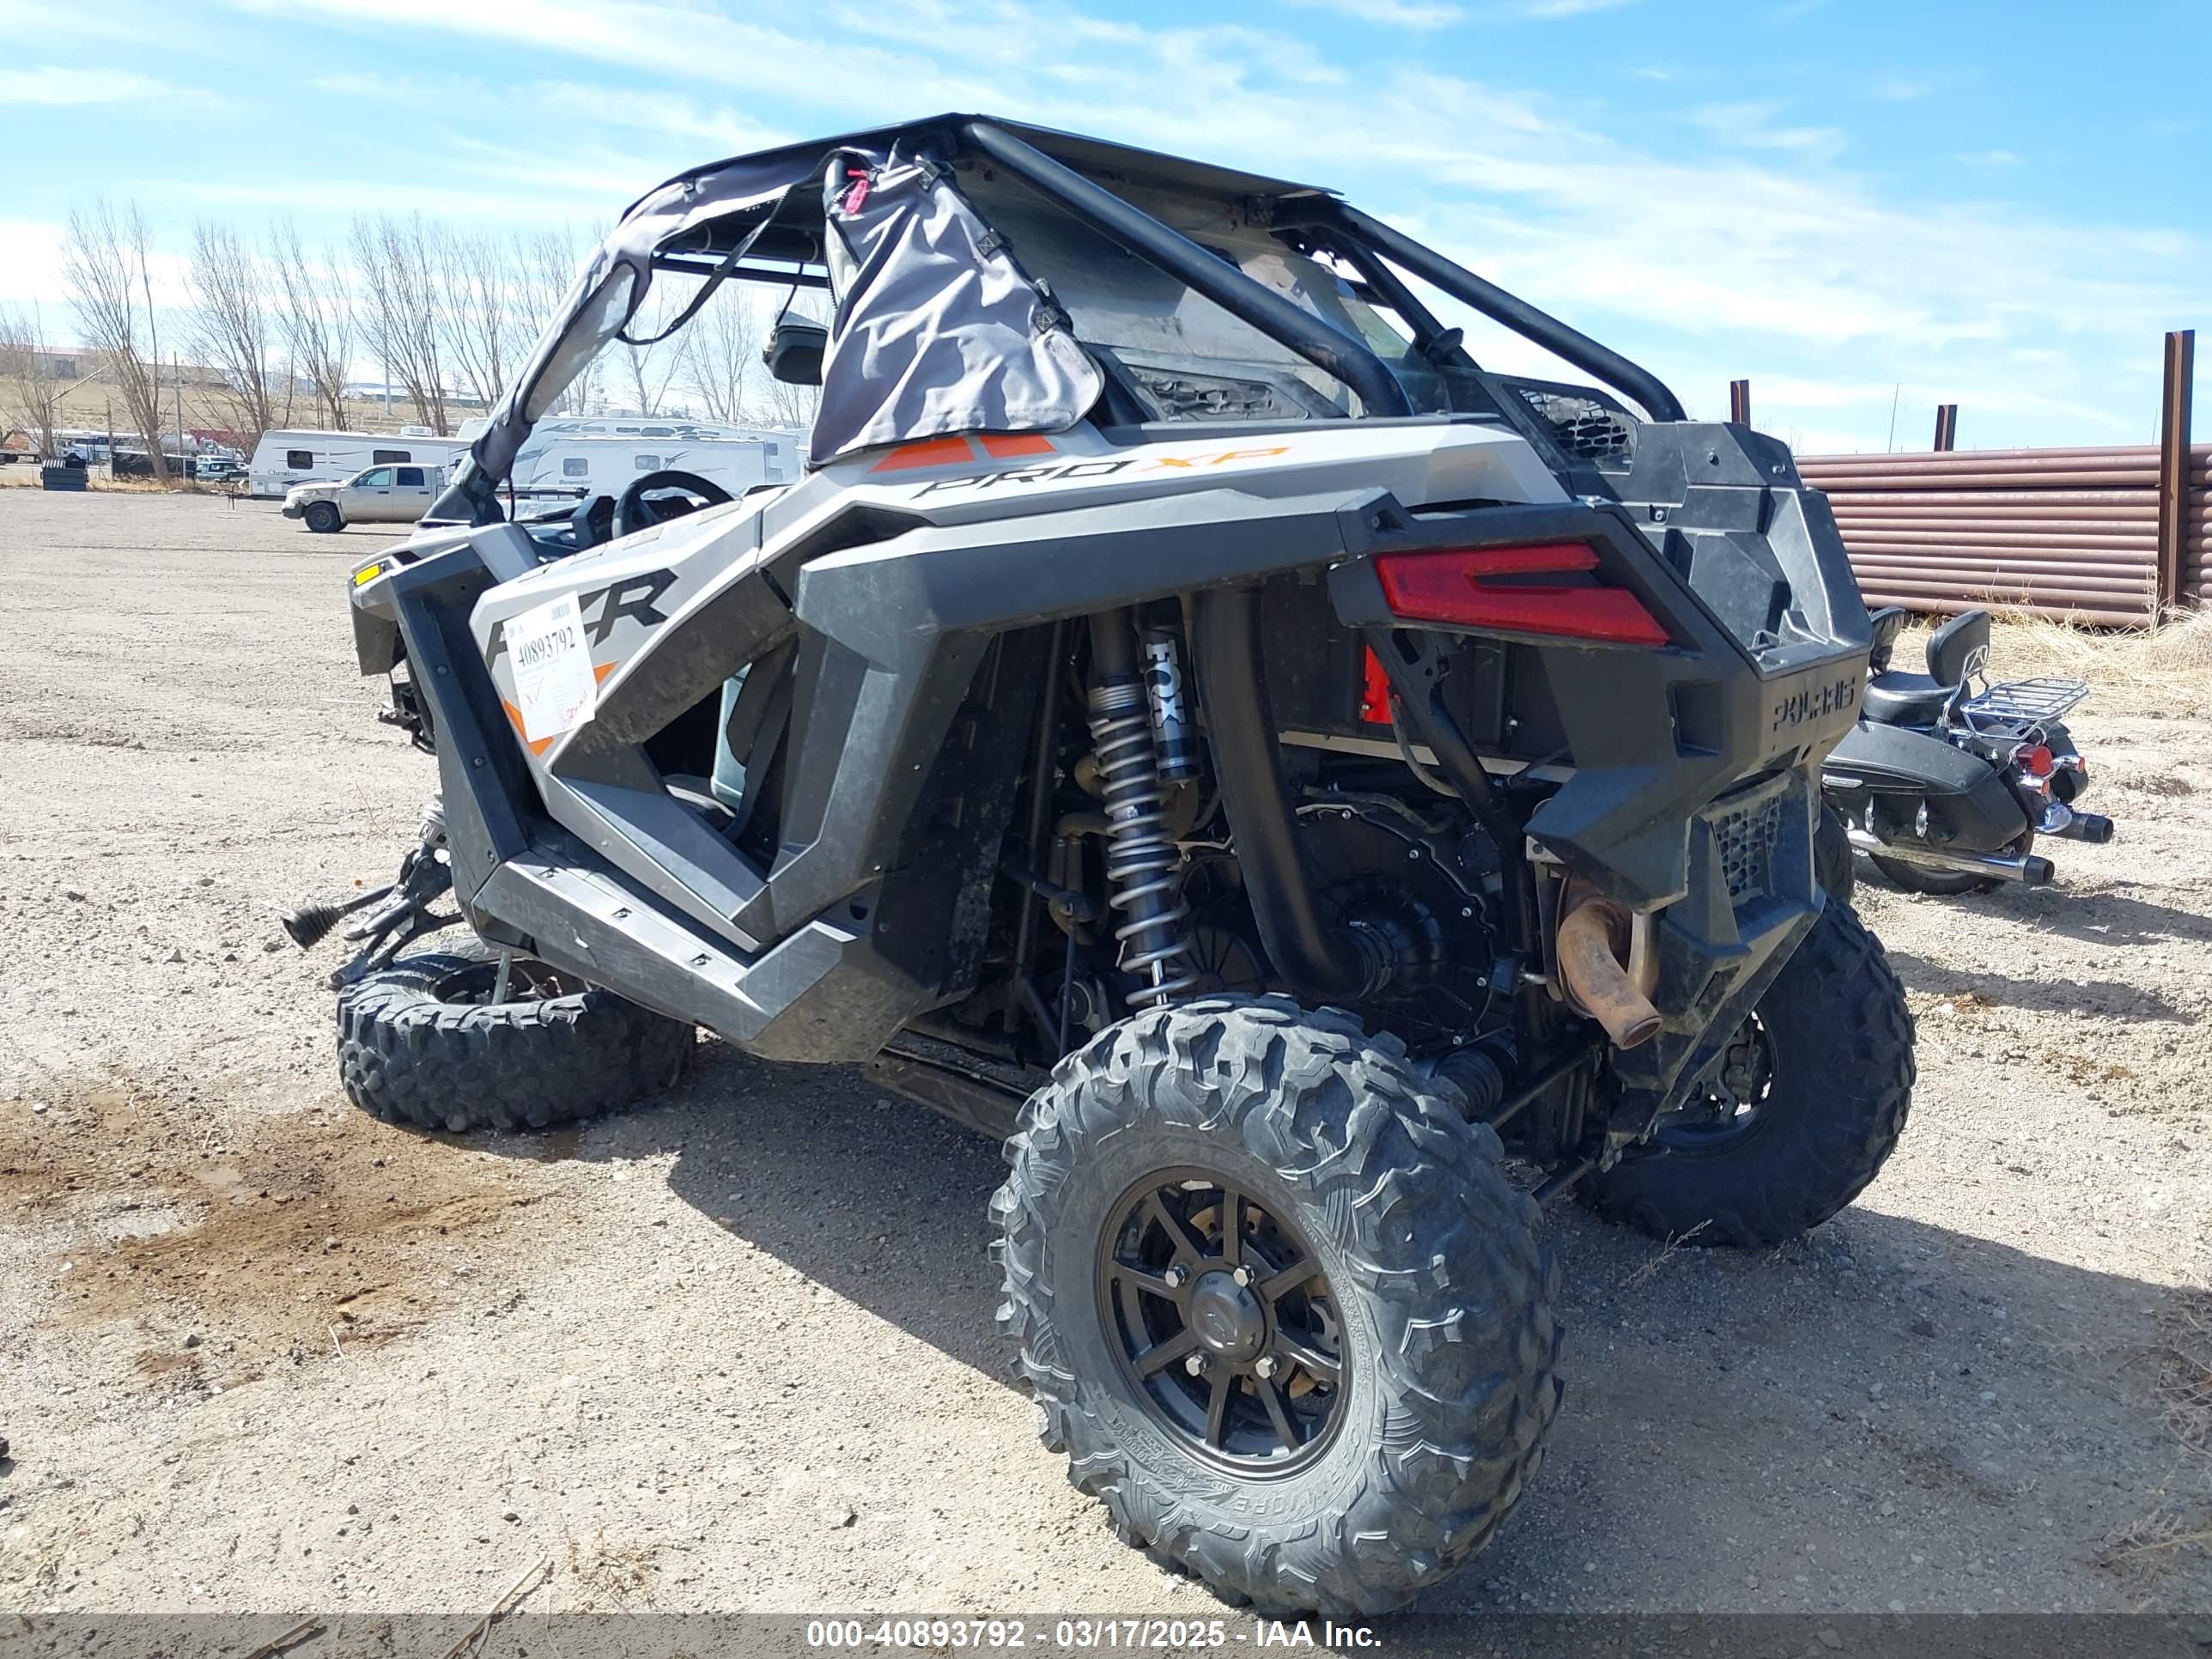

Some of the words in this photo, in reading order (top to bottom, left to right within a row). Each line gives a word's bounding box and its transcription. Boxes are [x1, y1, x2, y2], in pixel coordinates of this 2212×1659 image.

[909, 459, 1139, 501] PRO
[1135, 447, 1293, 473] XP
[518, 626, 576, 667] 40893792
[1146, 640, 1186, 729] FOX
[1773, 675, 1856, 732] POLARIS
